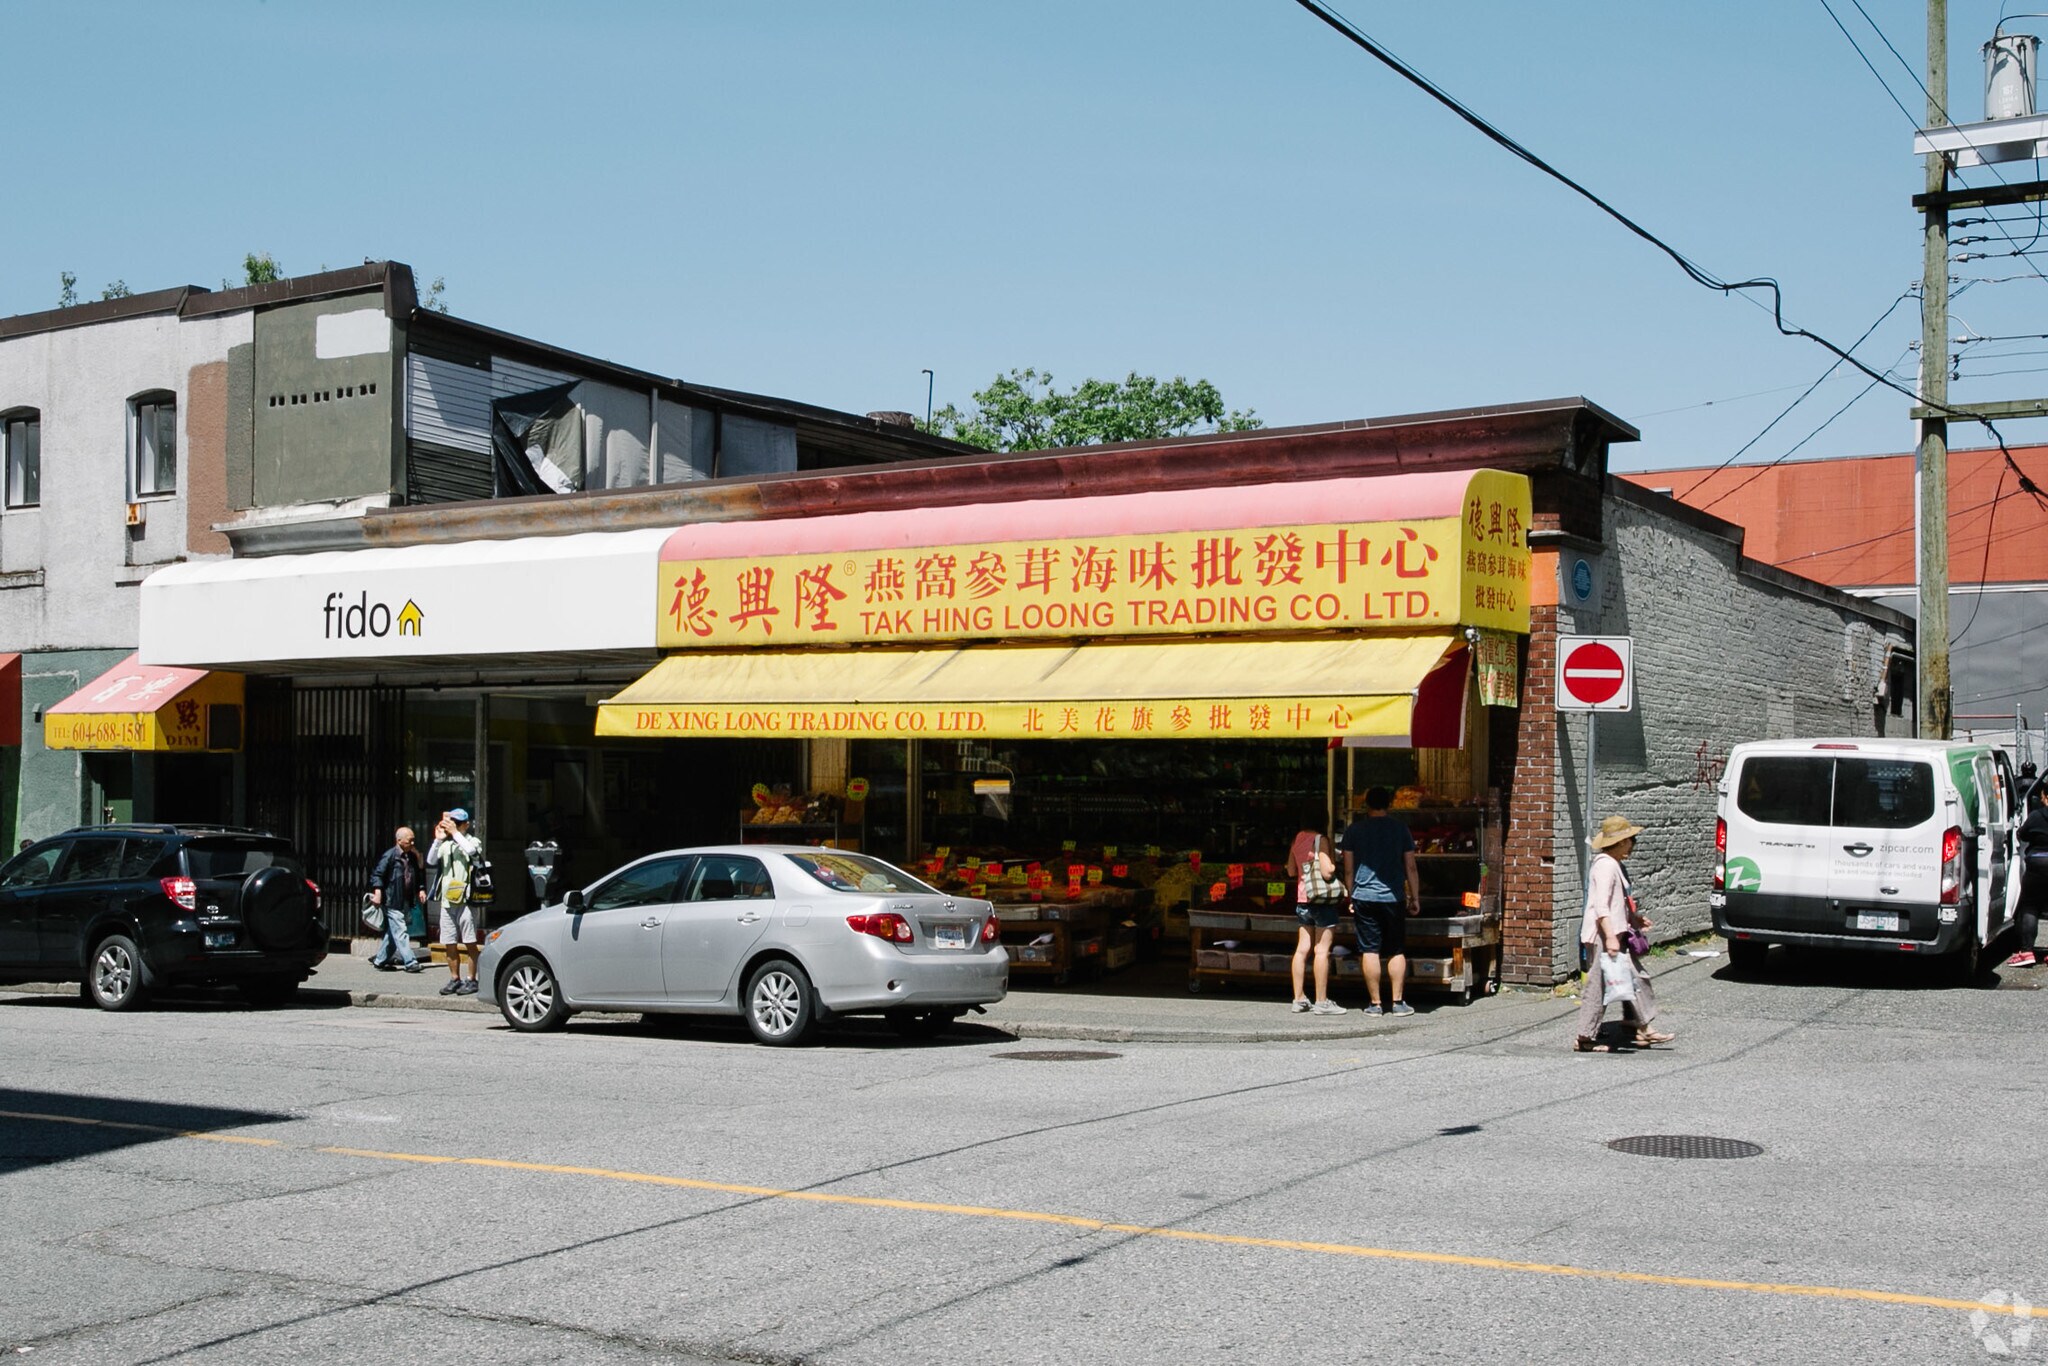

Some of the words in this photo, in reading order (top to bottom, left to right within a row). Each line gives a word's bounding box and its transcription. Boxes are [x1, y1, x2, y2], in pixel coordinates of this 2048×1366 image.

[1468, 495, 1522, 548] 德興隆
[669, 563, 847, 638] 德興隆
[864, 526, 1439, 606] 燕窩參茸海味批發中心
[323, 590, 391, 639] fido
[860, 609, 913, 635] TAK
[923, 605, 993, 633] HING
[1004, 601, 1114, 631] LOONG
[1128, 594, 1277, 626] TRADING
[1290, 592, 1349, 622] CO.
[1364, 590, 1439, 621] LTD.
[54, 726, 70, 738] TEL:
[72, 721, 147, 743] 604-688-1581
[636, 711, 661, 731] DE
[666, 711, 719, 731] XING
[725, 711, 782, 731] LONG
[787, 711, 888, 732] TRADING
[893, 711, 928, 732] CO.
[936, 710, 987, 732] LTD.
[1023, 703, 1354, 733] 北美花旗參批發中心
[166, 734, 199, 746] DIM
[1880, 843, 1935, 855] zipcar.com
